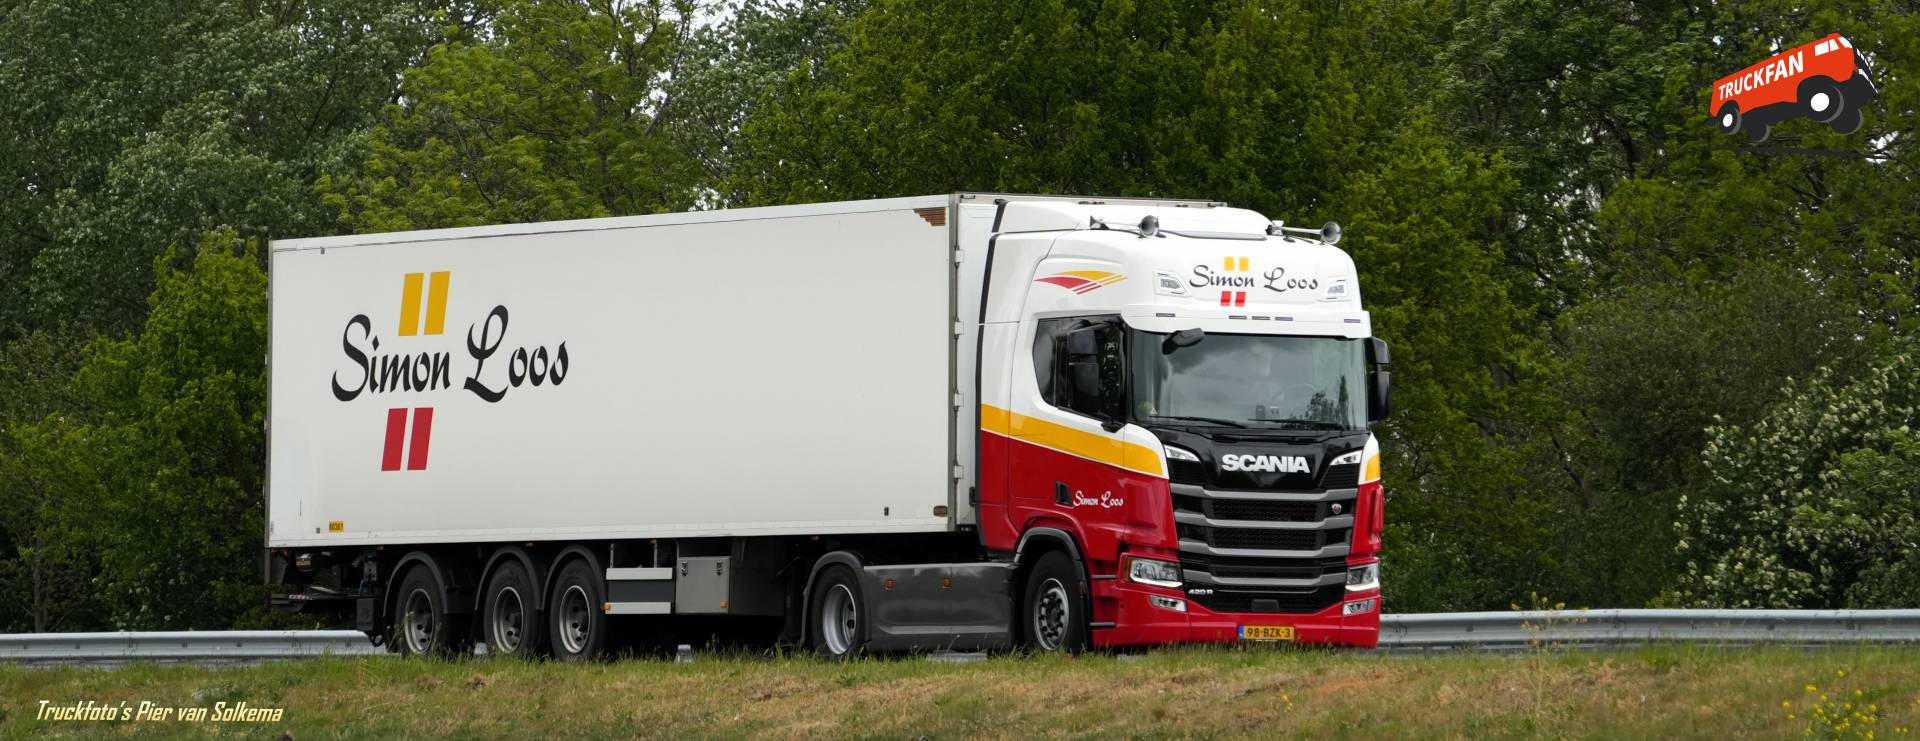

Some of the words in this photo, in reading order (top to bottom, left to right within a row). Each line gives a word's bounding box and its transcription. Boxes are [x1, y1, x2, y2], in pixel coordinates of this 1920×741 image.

[1189, 264, 1255, 288] Simon
[1263, 267, 1318, 292] Loos
[331, 313, 451, 402] Simon
[463, 304, 569, 403] Loos
[1221, 453, 1311, 474] SCANIA
[1073, 490, 1099, 506] Simon
[1100, 490, 1124, 508] Loos
[1247, 627, 1291, 638] 98-BZK-3
